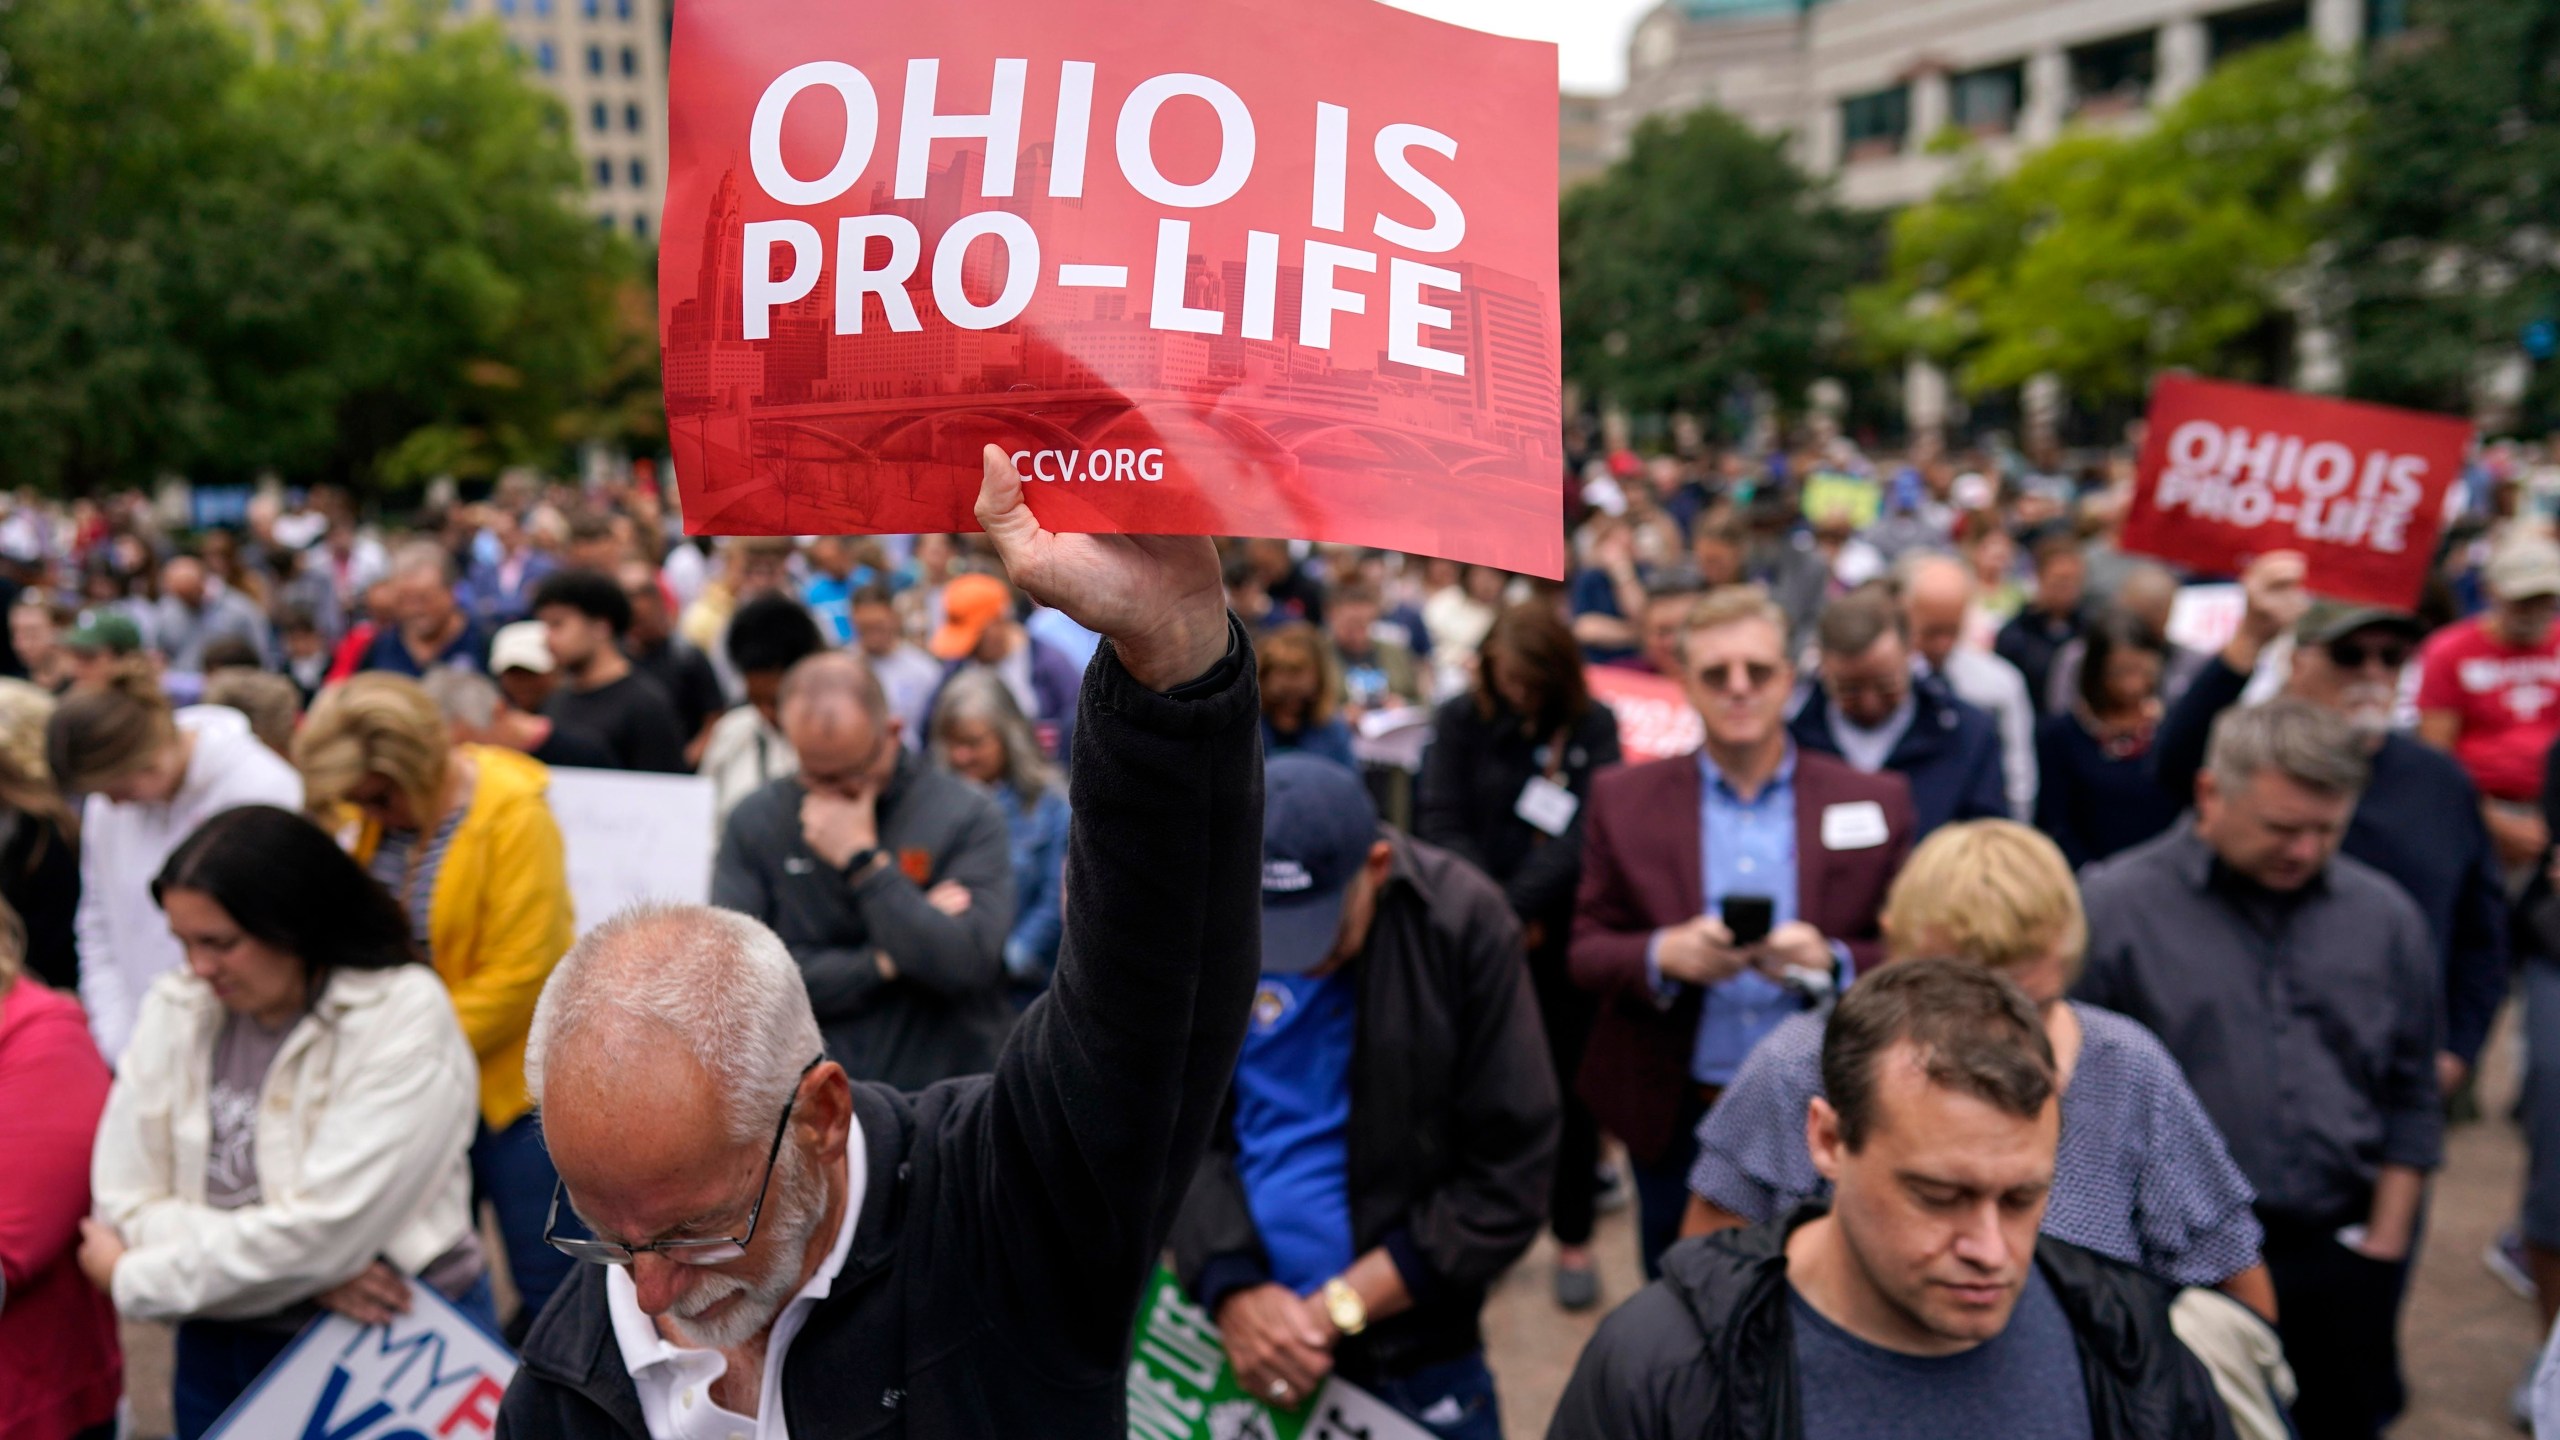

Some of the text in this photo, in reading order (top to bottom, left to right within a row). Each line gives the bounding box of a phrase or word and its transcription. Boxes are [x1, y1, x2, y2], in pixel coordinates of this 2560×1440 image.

[749, 58, 1467, 252] OHIO IS
[743, 212, 1466, 376] PRO-LIFE
[1010, 448, 1164, 482] CCV.ORG
[2168, 421, 2428, 512] OHIO IS
[2155, 469, 2410, 552] PRO-LIFE
[341, 1326, 479, 1412] MY
